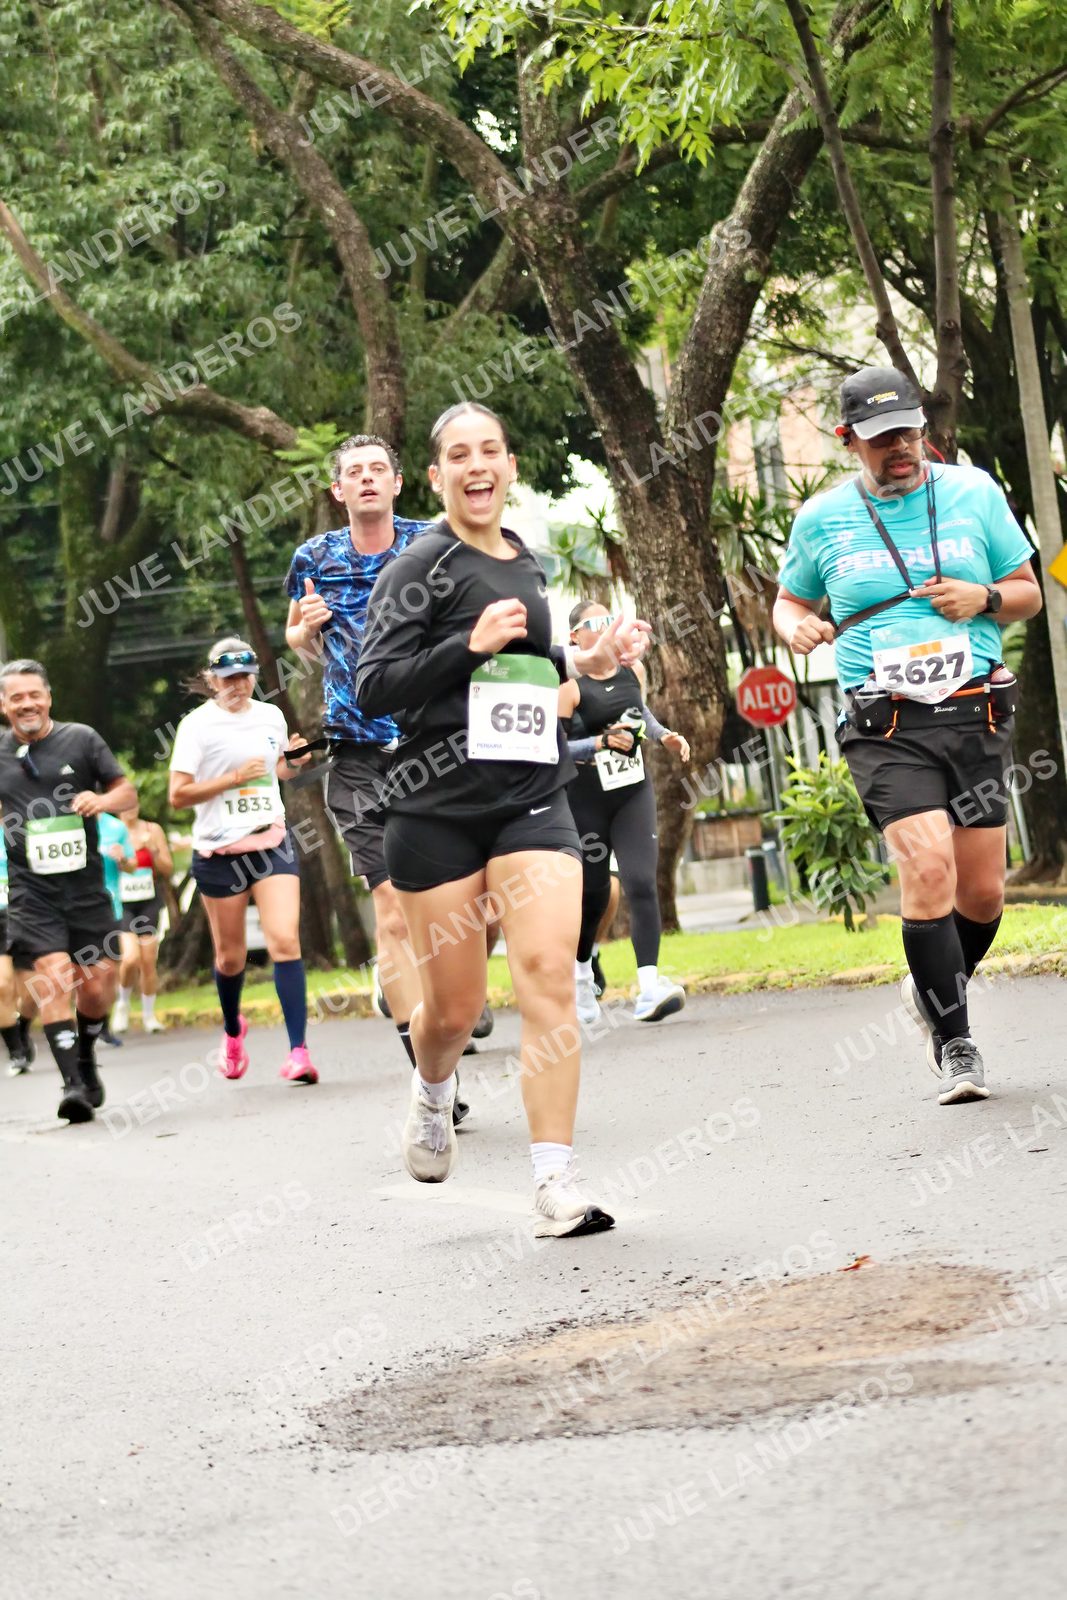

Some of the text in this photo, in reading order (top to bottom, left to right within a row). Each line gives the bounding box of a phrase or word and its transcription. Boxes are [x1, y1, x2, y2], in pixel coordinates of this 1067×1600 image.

[883, 651, 965, 690] 3627
[743, 681, 793, 711] ALTO
[490, 702, 546, 736] 659
[224, 796, 273, 815] 1833
[36, 840, 83, 861] 1803
